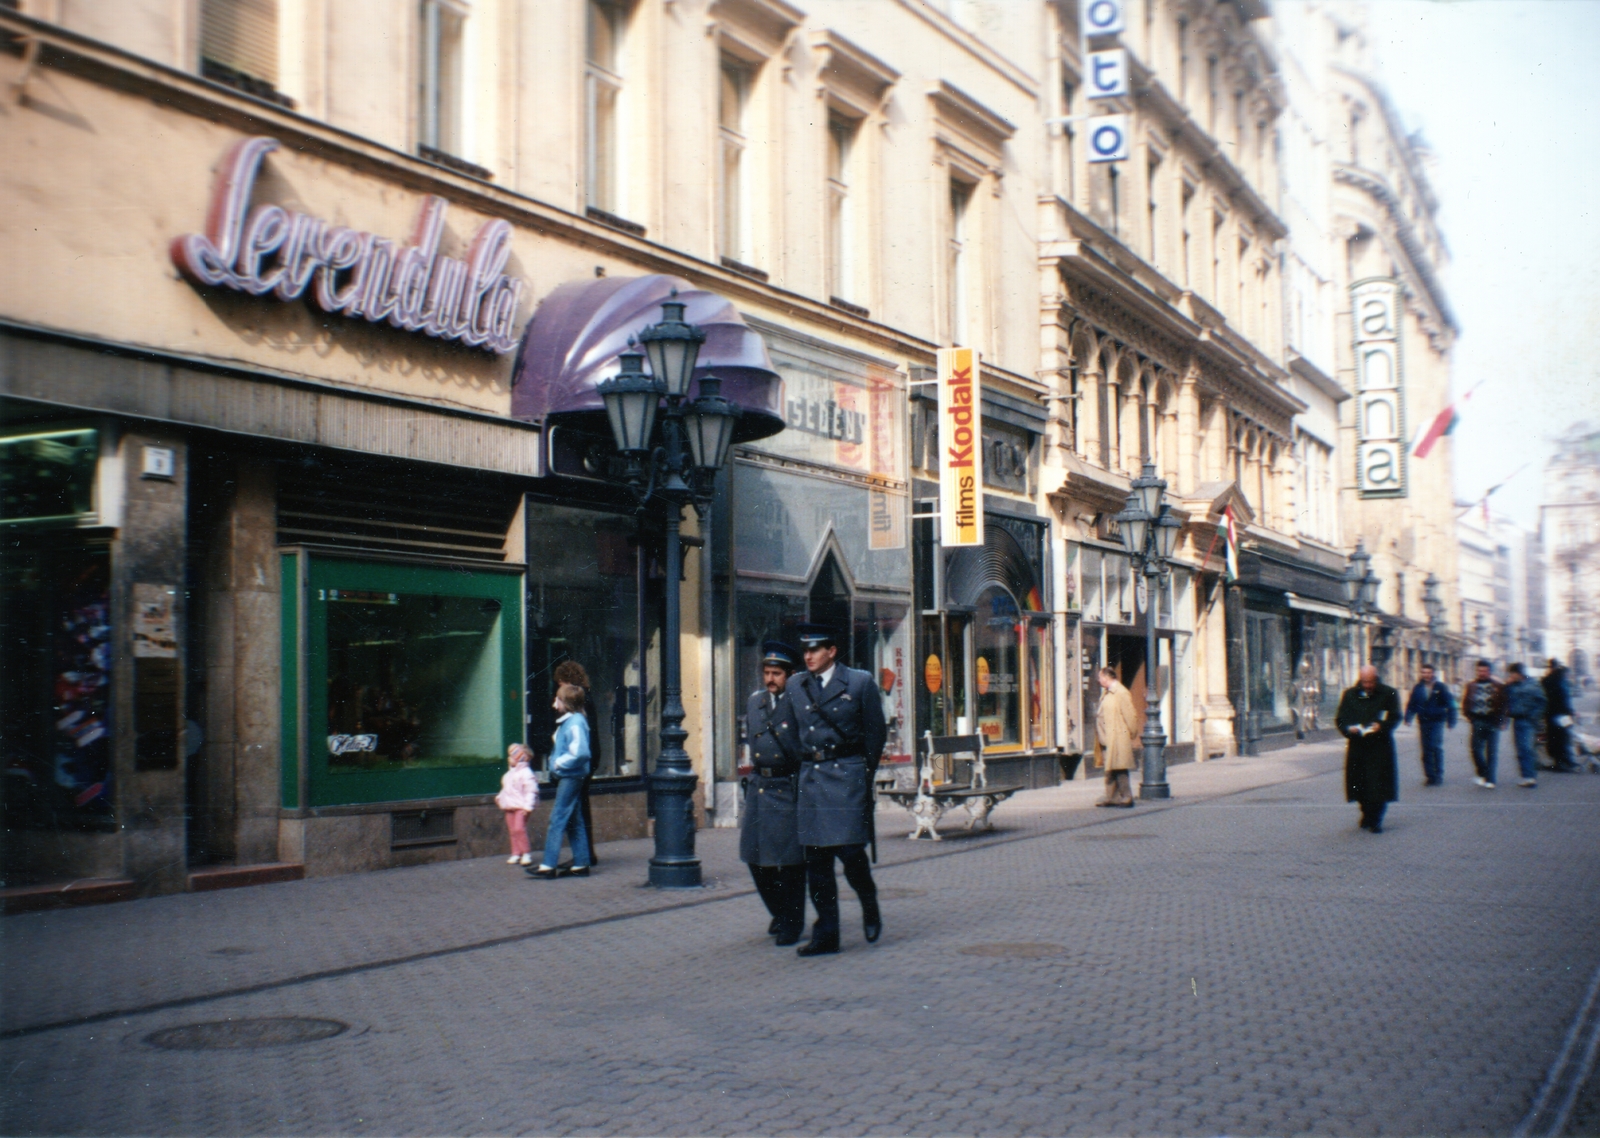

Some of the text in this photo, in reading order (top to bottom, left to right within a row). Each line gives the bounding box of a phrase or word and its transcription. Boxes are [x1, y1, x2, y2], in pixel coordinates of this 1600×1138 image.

[168, 135, 523, 354] Levendula
[947, 366, 974, 529] films Kodak
[1361, 299, 1398, 485] anna
